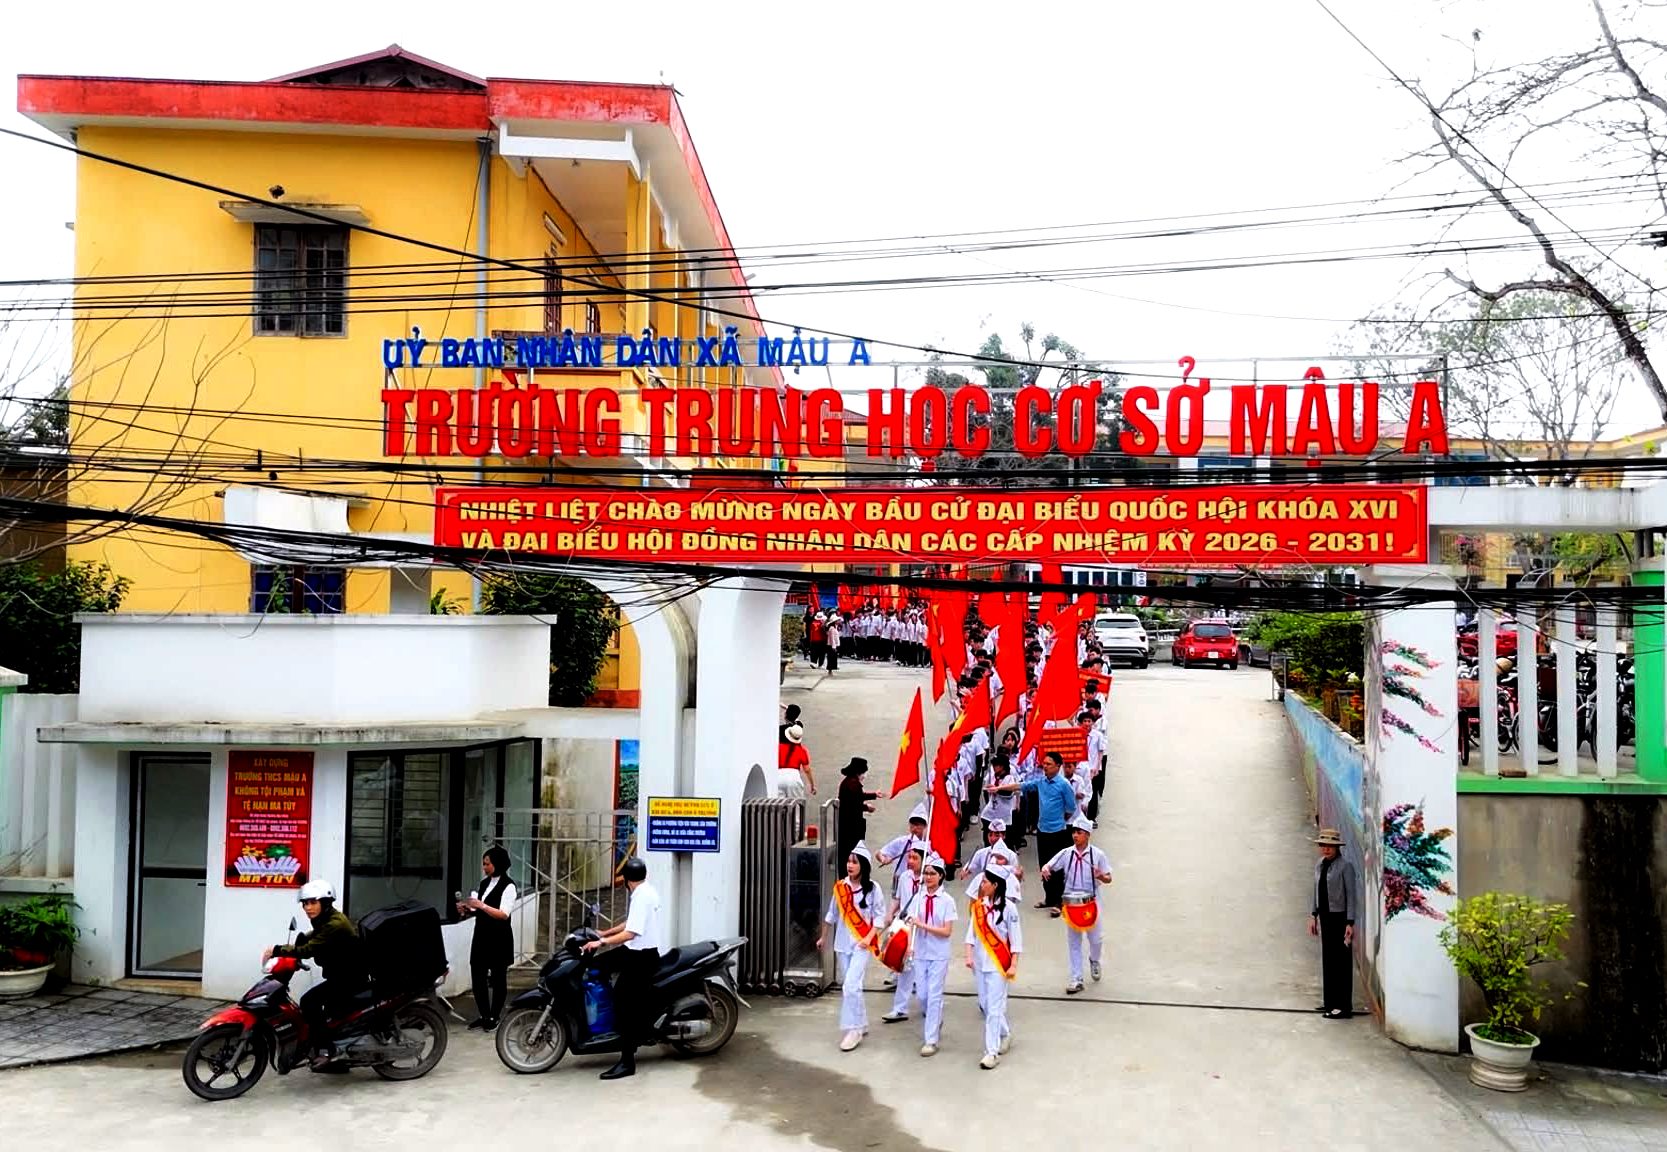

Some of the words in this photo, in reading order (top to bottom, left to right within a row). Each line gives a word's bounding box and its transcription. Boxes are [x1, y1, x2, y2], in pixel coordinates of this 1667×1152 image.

[442, 338, 504, 367] BAN
[517, 328, 602, 367] NHÂN
[696, 326, 742, 367] XÃ
[849, 338, 871, 366] A
[381, 369, 621, 457] TRƯỜNG
[641, 388, 844, 458] TRUNG
[867, 384, 991, 472] HỌC
[1015, 380, 1102, 457] CƠ
[1119, 356, 1210, 456] SỞ
[1230, 366, 1379, 467] MẬU
[1403, 381, 1449, 456] A
[460, 498, 537, 524] NHIỆT
[545, 498, 600, 525] LIỆT
[690, 498, 773, 520] MỪNG
[782, 498, 856, 520] NGÀY
[865, 496, 921, 520] BẦU
[931, 496, 971, 520] CỬ
[977, 501, 1025, 525] ĐẠI
[1034, 495, 1099, 520] BIỂU
[1109, 495, 1188, 522] QUỐC
[1198, 496, 1247, 523] HỘI
[1258, 496, 1339, 519] KHÓA
[1349, 500, 1398, 519] XVI
[461, 528, 494, 549] VÀ
[503, 532, 548, 553] ĐẠI
[558, 525, 618, 550] BIỂU
[628, 529, 673, 554] HỘI
[682, 527, 757, 551] ĐỒNG
[767, 529, 844, 551] NHÂN
[854, 529, 911, 551] DÂN
[921, 529, 977, 551] CÁC
[987, 527, 1043, 551] CẤP
[1054, 529, 1148, 555] NHIỆM
[1158, 528, 1195, 551] KỲ
[1205, 533, 1277, 551] 2026
[1309, 533, 1394, 551] 2031!
